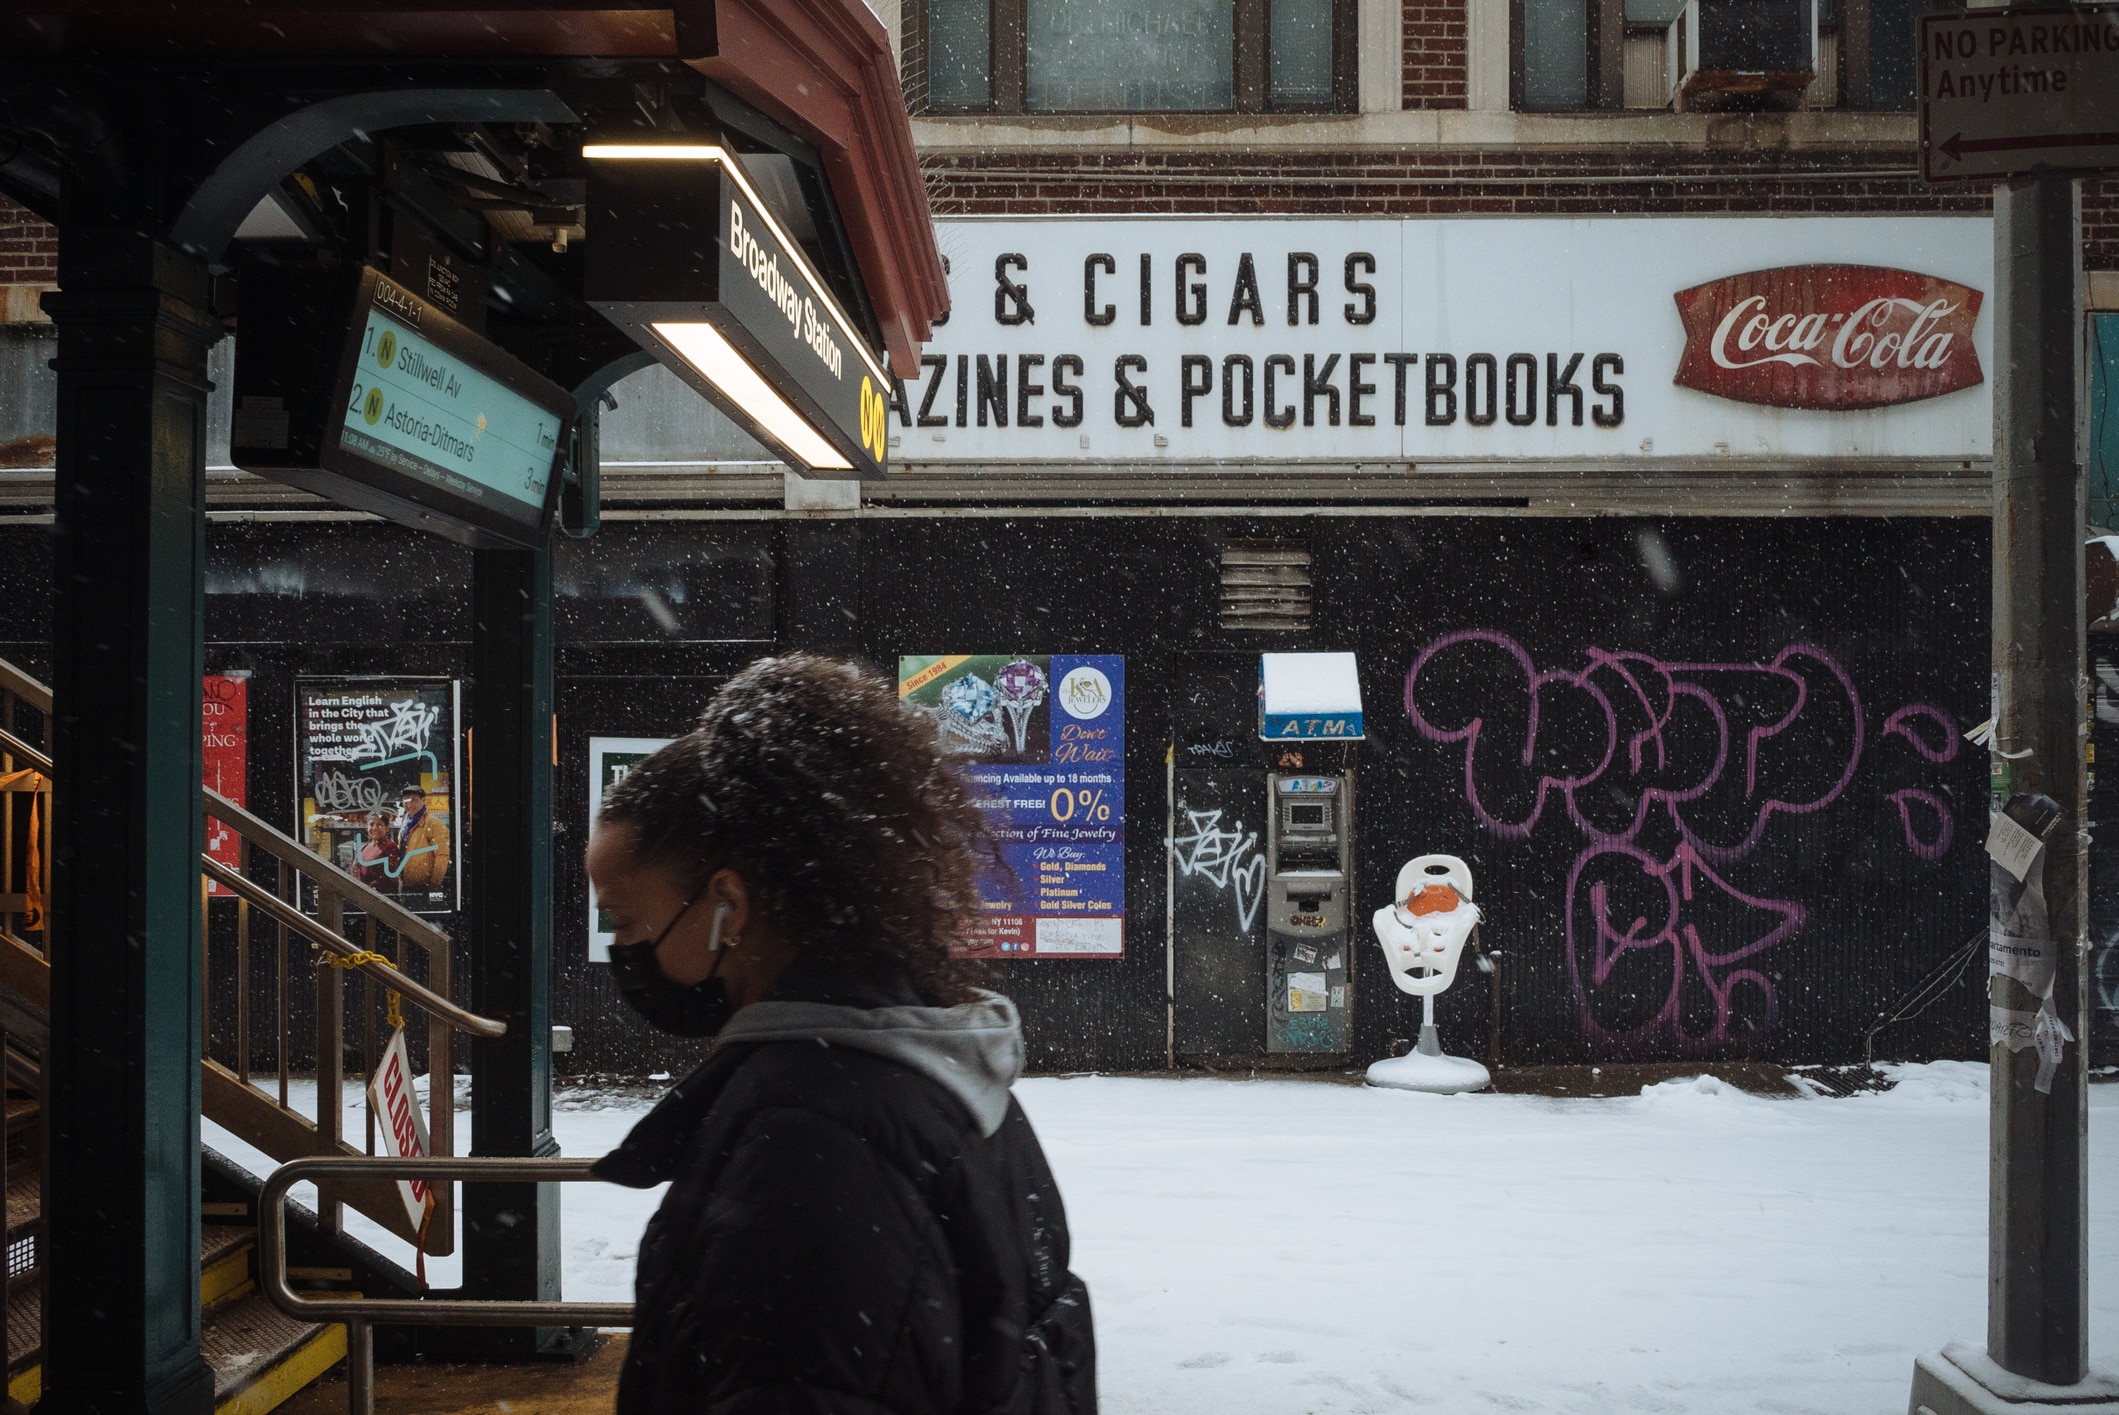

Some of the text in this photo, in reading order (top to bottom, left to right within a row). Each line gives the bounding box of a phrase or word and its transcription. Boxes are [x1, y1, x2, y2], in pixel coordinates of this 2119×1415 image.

[1101, 10, 1208, 36] MICHAEL
[1935, 23, 2119, 60] NO PARKING
[1937, 65, 2067, 103] Anytime
[731, 199, 842, 381] Broadway Station
[994, 252, 1377, 326] & CIGARS
[376, 281, 423, 322] 004-4-1-1
[1710, 295, 1960, 369] Coca-Cola
[366, 326, 555, 452] 1. N Stillwell Av 1 min
[1114, 353, 1154, 427] &
[1181, 352, 1625, 428] POCKETBOOKS
[349, 383, 545, 496] 2. N Astoria-Ditmars 3 min
[357, 437, 369, 451] AM
[906, 662, 948, 690] Since 1984
[309, 696, 382, 708] Learn English
[309, 708, 389, 719] in the City that
[309, 722, 343, 732] brings
[1281, 719, 1346, 735] ATM
[309, 734, 341, 743] whole
[1003, 773, 1042, 784] Available
[1044, 775, 1055, 786] up
[1057, 774, 1066, 783] to
[1068, 773, 1078, 783] 18
[1080, 773, 1112, 783] months
[1014, 799, 1046, 809] FREE!
[1051, 787, 1110, 822] 0%
[1027, 826, 1042, 843] of
[1042, 828, 1069, 839] Fine
[1070, 826, 1116, 843] Jewelry
[1033, 846, 1056, 860] We
[1040, 862, 1107, 873] Gold, Diamonds
[1040, 875, 1065, 885] Silver
[1040, 888, 1079, 897] Platinum
[1040, 901, 1112, 910] Gold Silver Coins
[992, 918, 1001, 926] NY
[1003, 918, 1023, 926] 11106
[999, 927, 1021, 936] Kevin)
